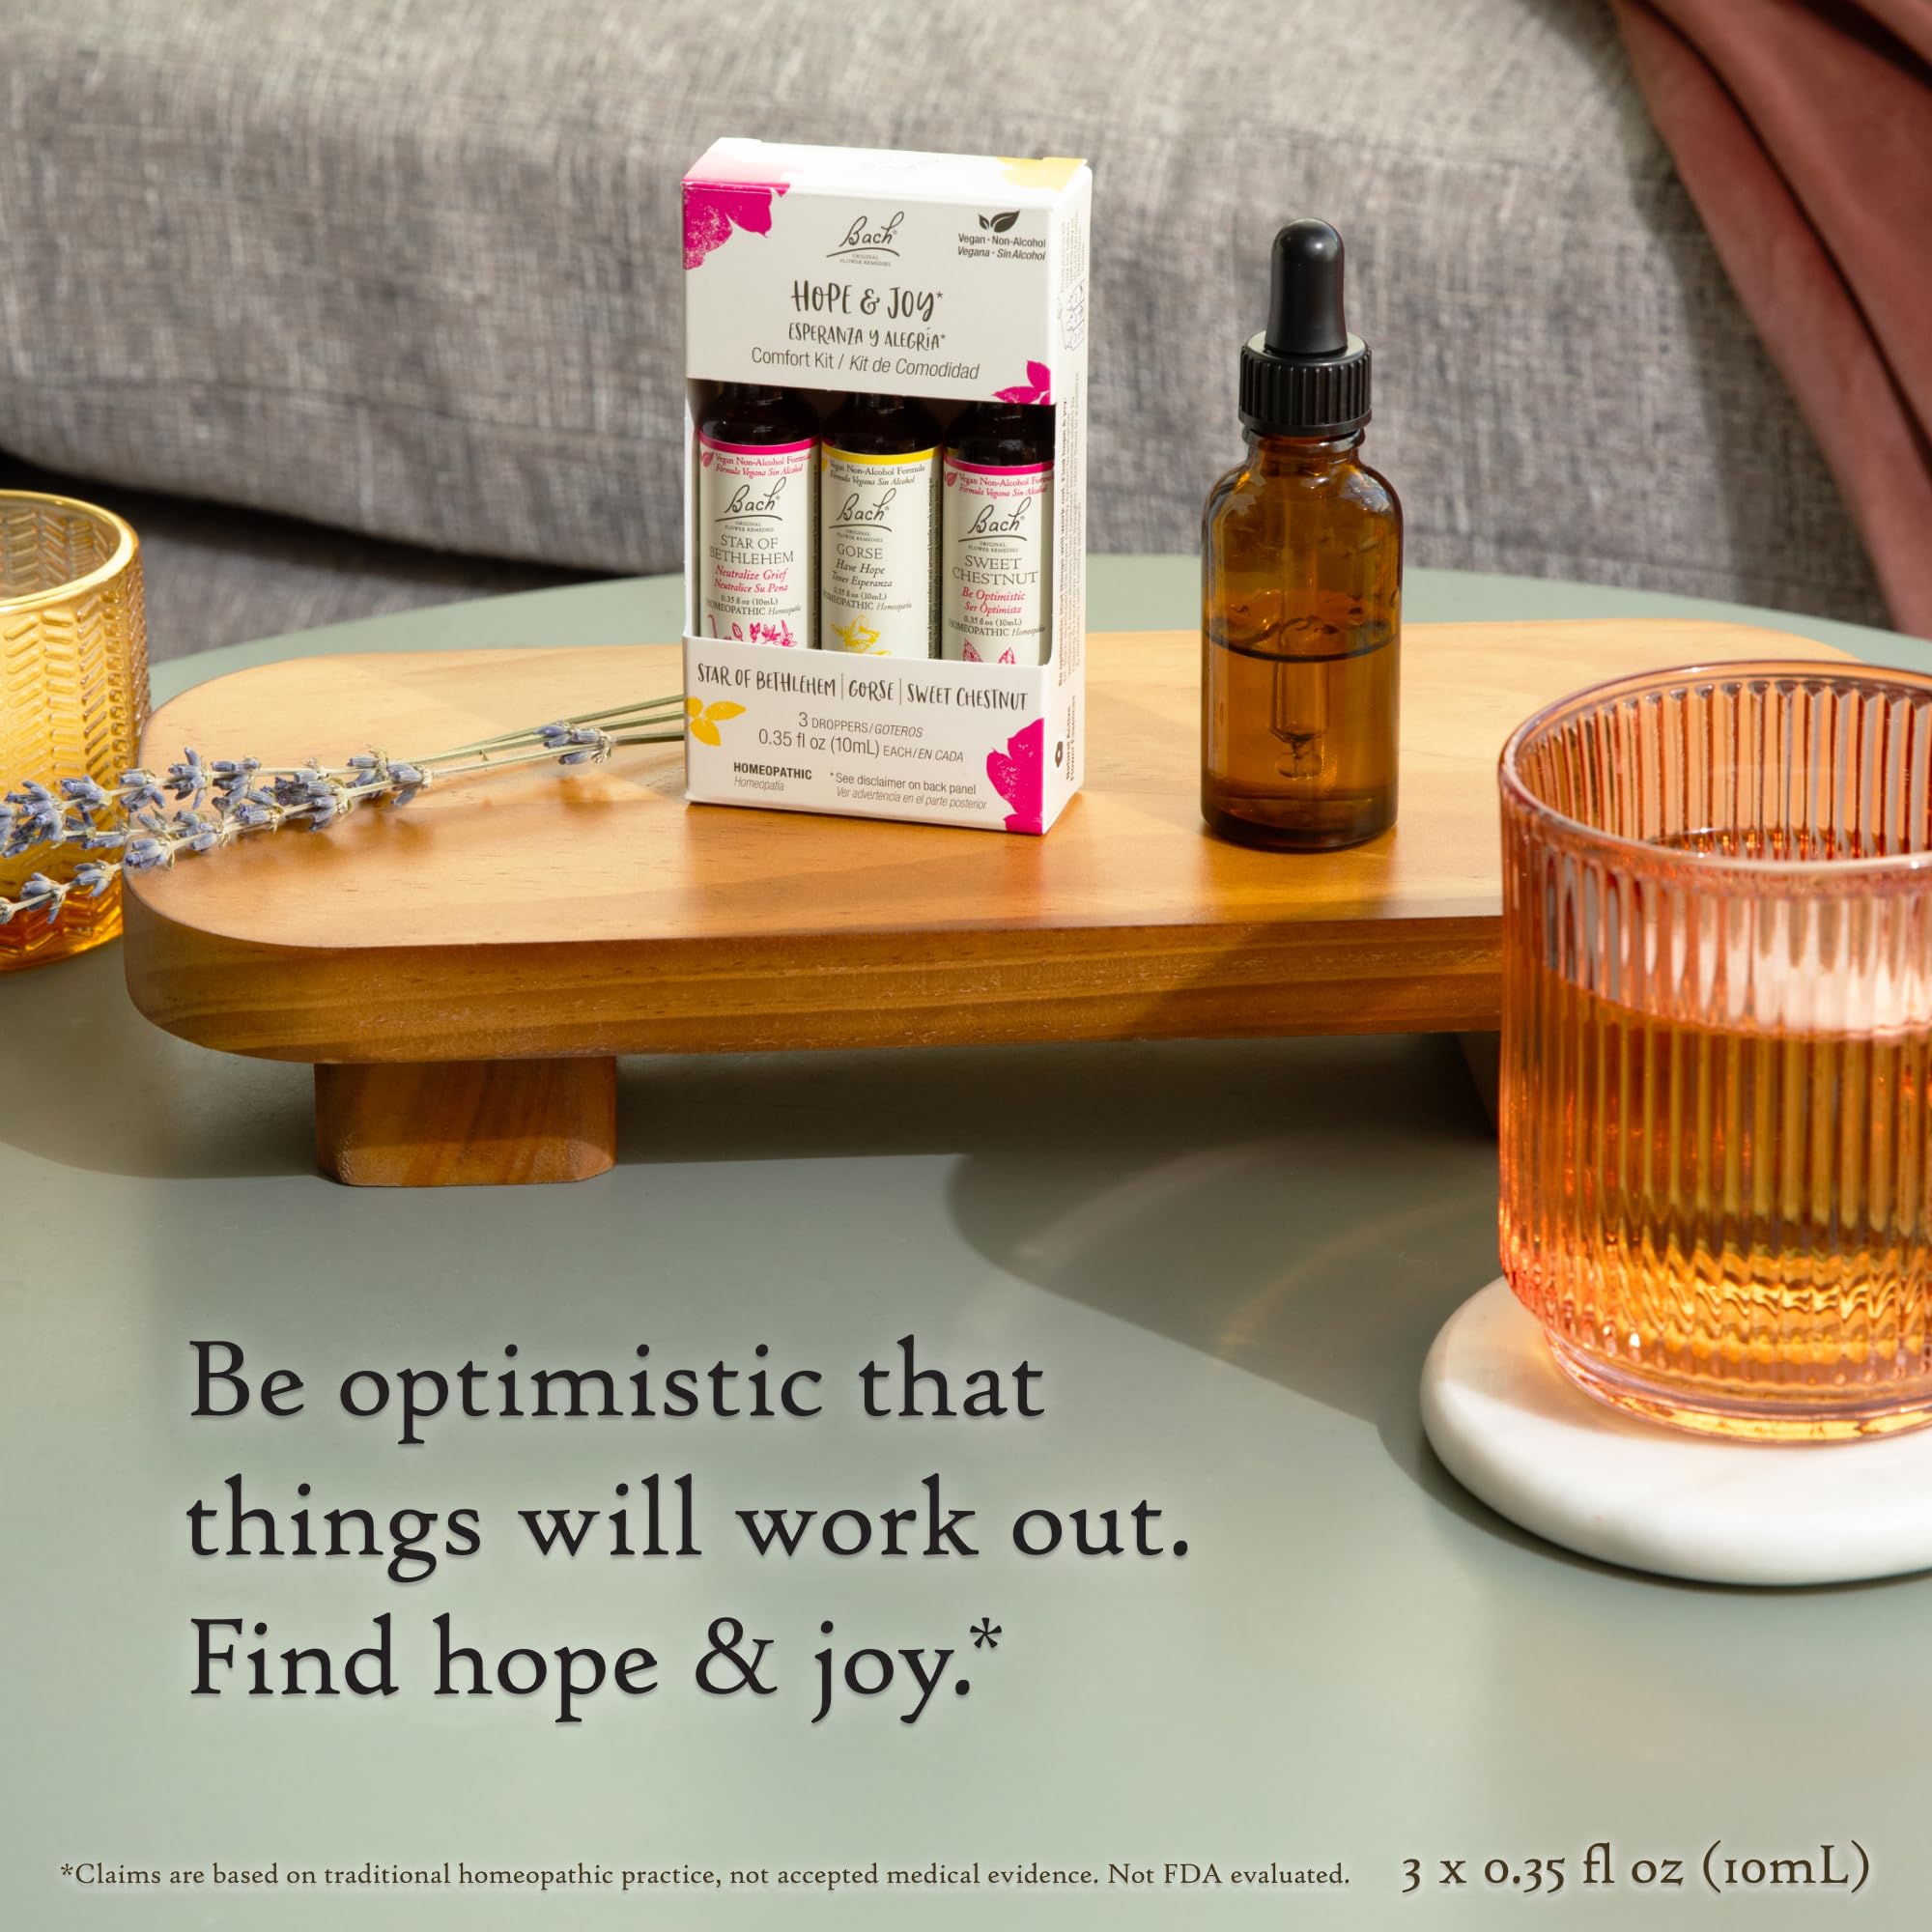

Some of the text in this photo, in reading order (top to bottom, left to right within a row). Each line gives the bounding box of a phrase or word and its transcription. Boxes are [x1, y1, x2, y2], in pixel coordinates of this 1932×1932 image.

[958, 233, 1046, 248] Vegan Non-Alcohol
[958, 246, 1046, 261] Vegana Sin Alcohol
[791, 279, 852, 314] HOPE
[860, 288, 880, 315] &
[788, 322, 863, 345] ESPERANZA
[752, 347, 980, 380] Comfort Kit Kit de Comodidad
[736, 456, 784, 467] Non-Alcohol
[846, 465, 895, 475] Non-Alcohol
[721, 534, 778, 550] STAR OF
[837, 543, 883, 559] GORSE
[710, 546, 794, 564] BETHLEHEM
[965, 554, 1022, 570] SWEET
[715, 564, 788, 582] Neutralize Grief
[836, 558, 886, 578] Have Hope
[952, 567, 1038, 585] CHESTNUT
[714, 578, 752, 593] Neutralice
[754, 583, 765, 593] Su
[851, 576, 893, 589] Esperanza
[961, 586, 1025, 605] Be Optimistic
[965, 601, 1021, 616] Ser Optimista
[697, 663, 1028, 711] STAR OF BETHLEHEM GORSE SWEET CHESTNUT
[798, 711, 809, 727] 3
[758, 728, 792, 747] 0.35
[797, 731, 805, 749] fl
[810, 736, 826, 751] oz
[830, 735, 880, 758] (10mL)
[934, 749, 964, 762] CADA
[733, 762, 812, 780] HOMEOPATHIC
[857, 775, 906, 788] disclaimer
[908, 780, 921, 788] on
[923, 781, 947, 792] back
[950, 783, 977, 795] panel
[837, 786, 987, 810] Ver advertencia en el parte posterior
